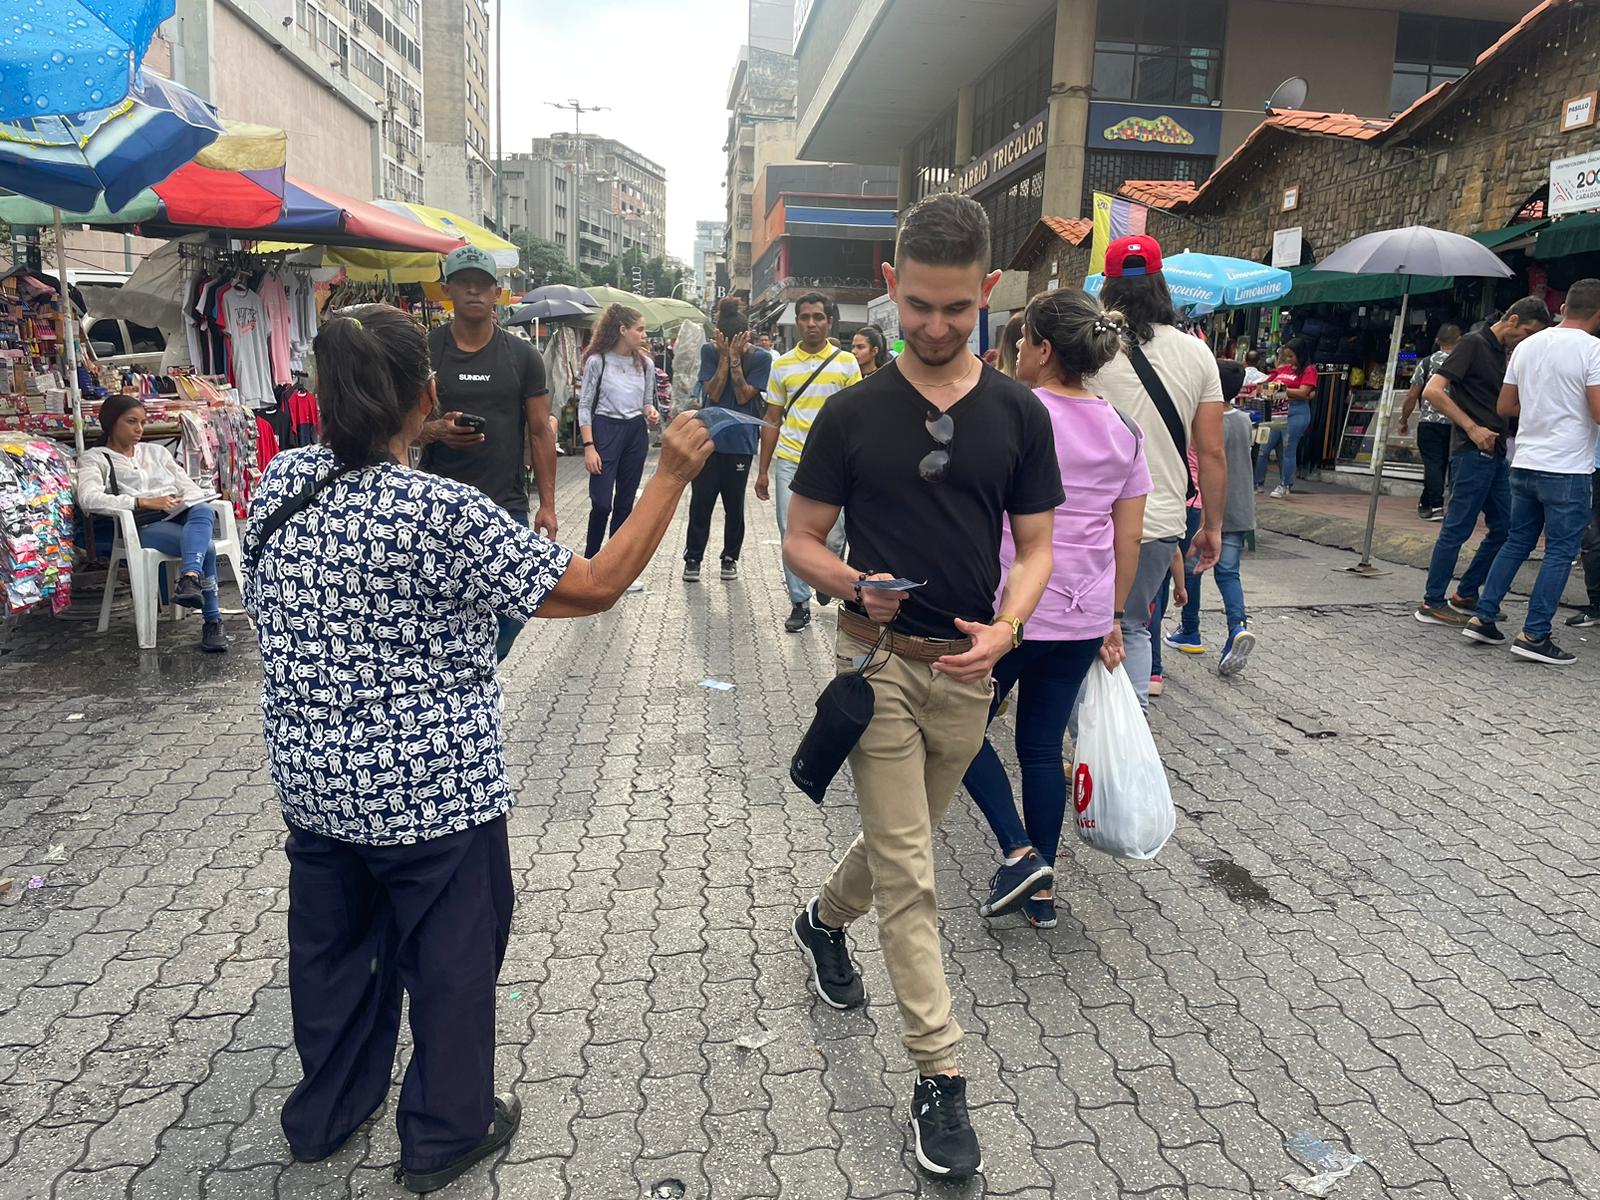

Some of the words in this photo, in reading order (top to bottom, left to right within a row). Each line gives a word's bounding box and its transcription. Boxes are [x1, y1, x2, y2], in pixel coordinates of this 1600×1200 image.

[1568, 102, 1589, 113] PASILLO
[958, 160, 988, 194] BARRIO
[993, 121, 1044, 172] TRICOLOR
[1235, 281, 1282, 301] Limousine
